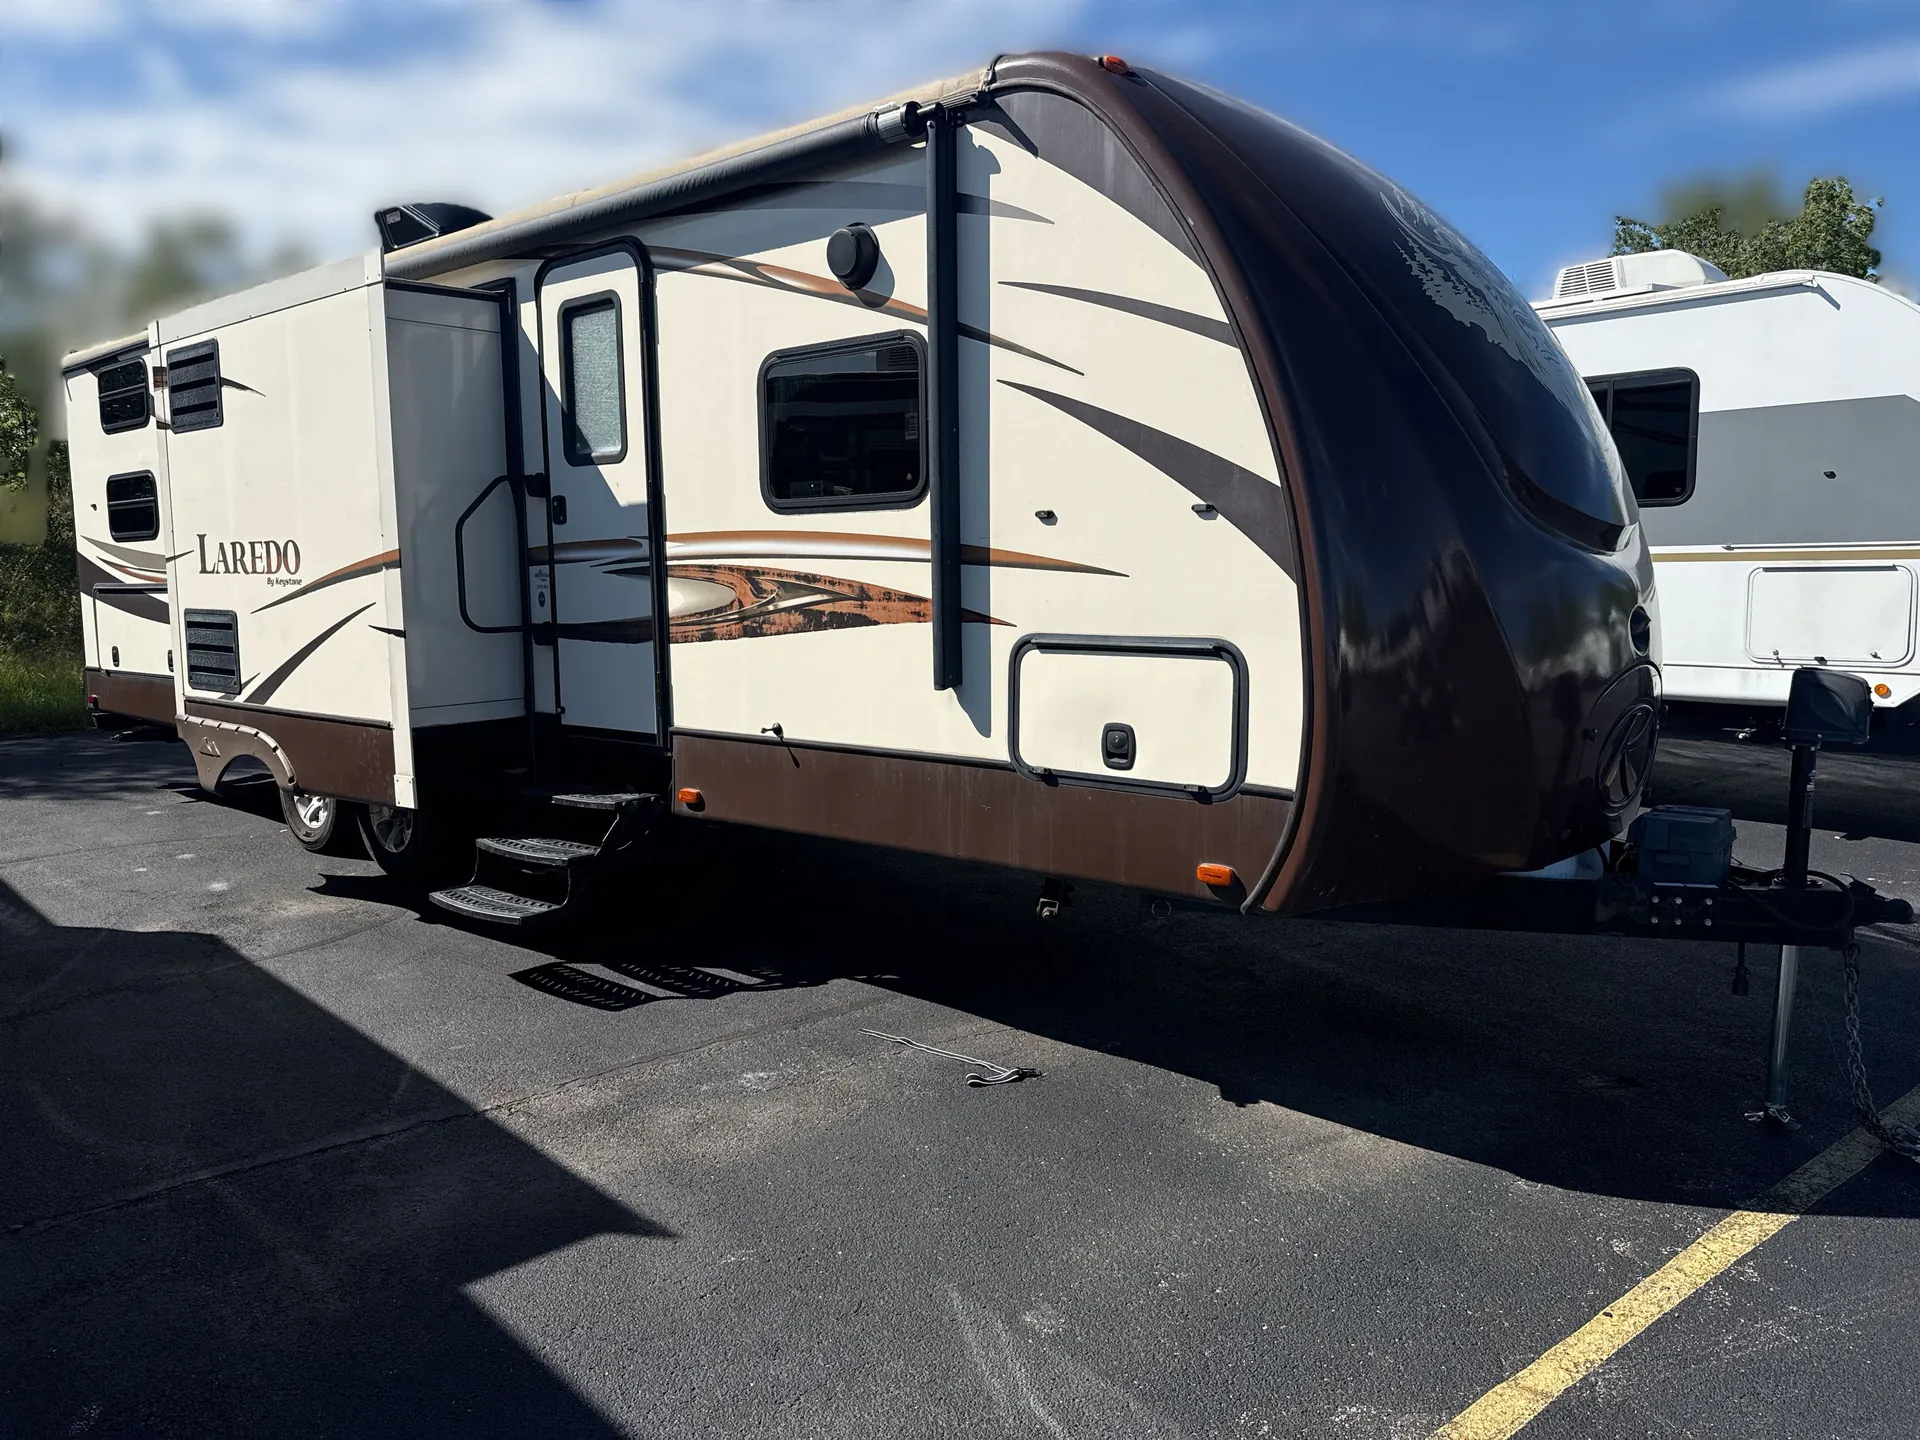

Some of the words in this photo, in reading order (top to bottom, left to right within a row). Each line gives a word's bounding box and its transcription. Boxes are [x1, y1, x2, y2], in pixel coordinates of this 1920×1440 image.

[196, 533, 301, 575] LAREDO
[267, 577, 274, 587] By
[275, 577, 302, 587] Keystone
